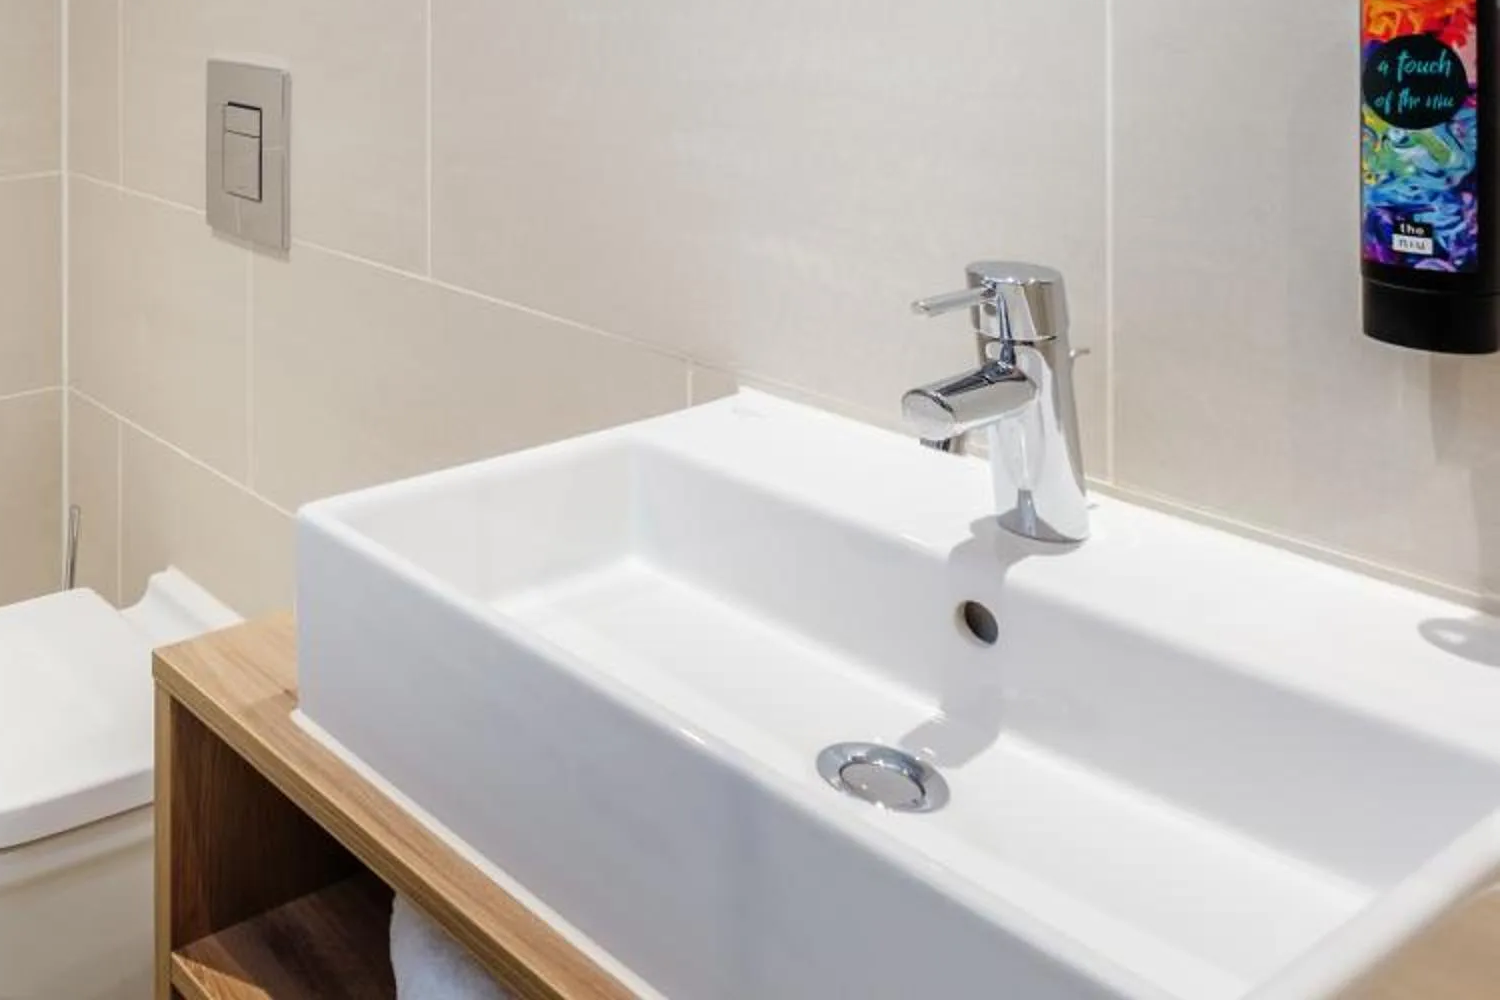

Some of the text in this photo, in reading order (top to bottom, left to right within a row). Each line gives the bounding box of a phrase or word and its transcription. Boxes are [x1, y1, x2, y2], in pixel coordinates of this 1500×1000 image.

[1377, 48, 1452, 83] a touch
[1374, 89, 1394, 116] of
[1399, 223, 1425, 235] the
